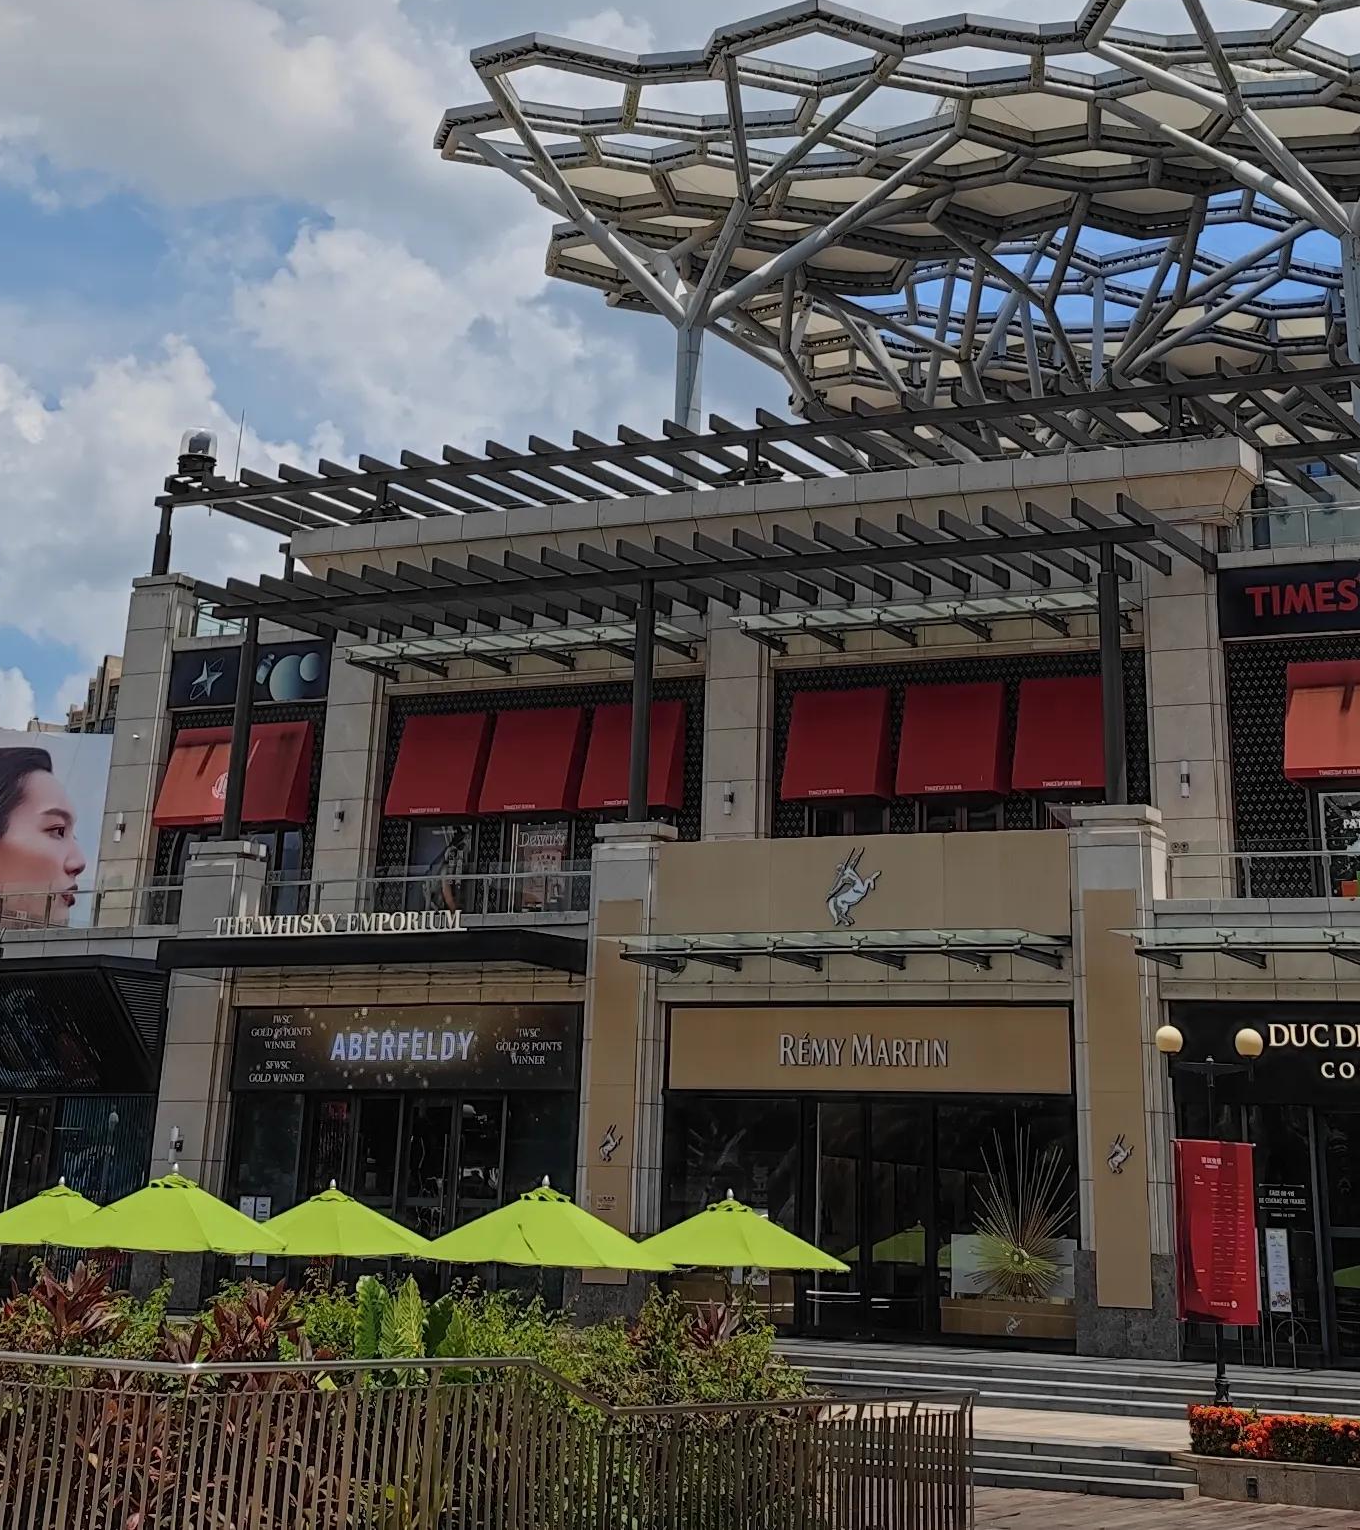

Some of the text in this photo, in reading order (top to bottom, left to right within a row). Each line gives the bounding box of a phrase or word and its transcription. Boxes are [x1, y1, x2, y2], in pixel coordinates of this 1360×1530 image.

[213, 909, 463, 936] THE WHISKY EMPORIUM
[273, 1014, 293, 1024] IWSC
[251, 1026, 273, 1037] GOLD
[283, 1026, 312, 1037] POINTS
[1268, 1023, 1330, 1047] DUC
[264, 1040, 296, 1050] WINNER
[330, 1029, 475, 1062] ABERFELDY
[496, 1041, 562, 1052] GOLD 95 POINTS
[779, 1031, 949, 1068] RÉMY MARTIN
[511, 1055, 545, 1065] WINNER
[249, 1073, 305, 1084] GOLD WINNER
